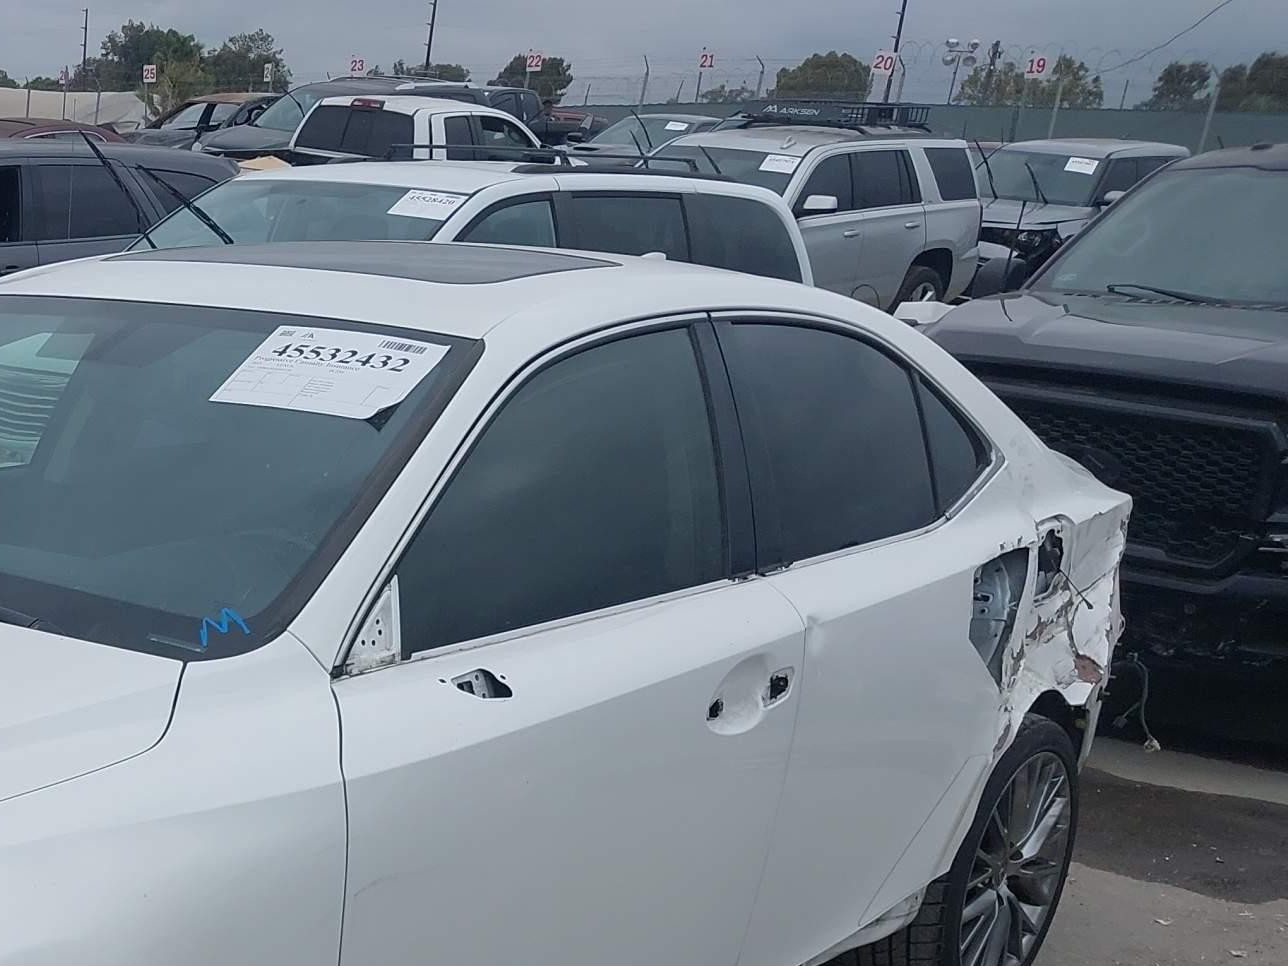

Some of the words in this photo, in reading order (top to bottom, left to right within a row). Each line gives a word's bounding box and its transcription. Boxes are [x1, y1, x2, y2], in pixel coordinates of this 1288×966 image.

[350, 59, 364, 72] 23
[527, 54, 542, 68] 22
[699, 54, 714, 68] 21
[873, 55, 894, 70] 20
[1026, 57, 1046, 74] 19
[144, 68, 156, 80] 25
[254, 355, 294, 364] Progressive
[326, 362, 360, 371] Insurance
[271, 343, 411, 373] 45532432
[199, 607, 251, 649] M
